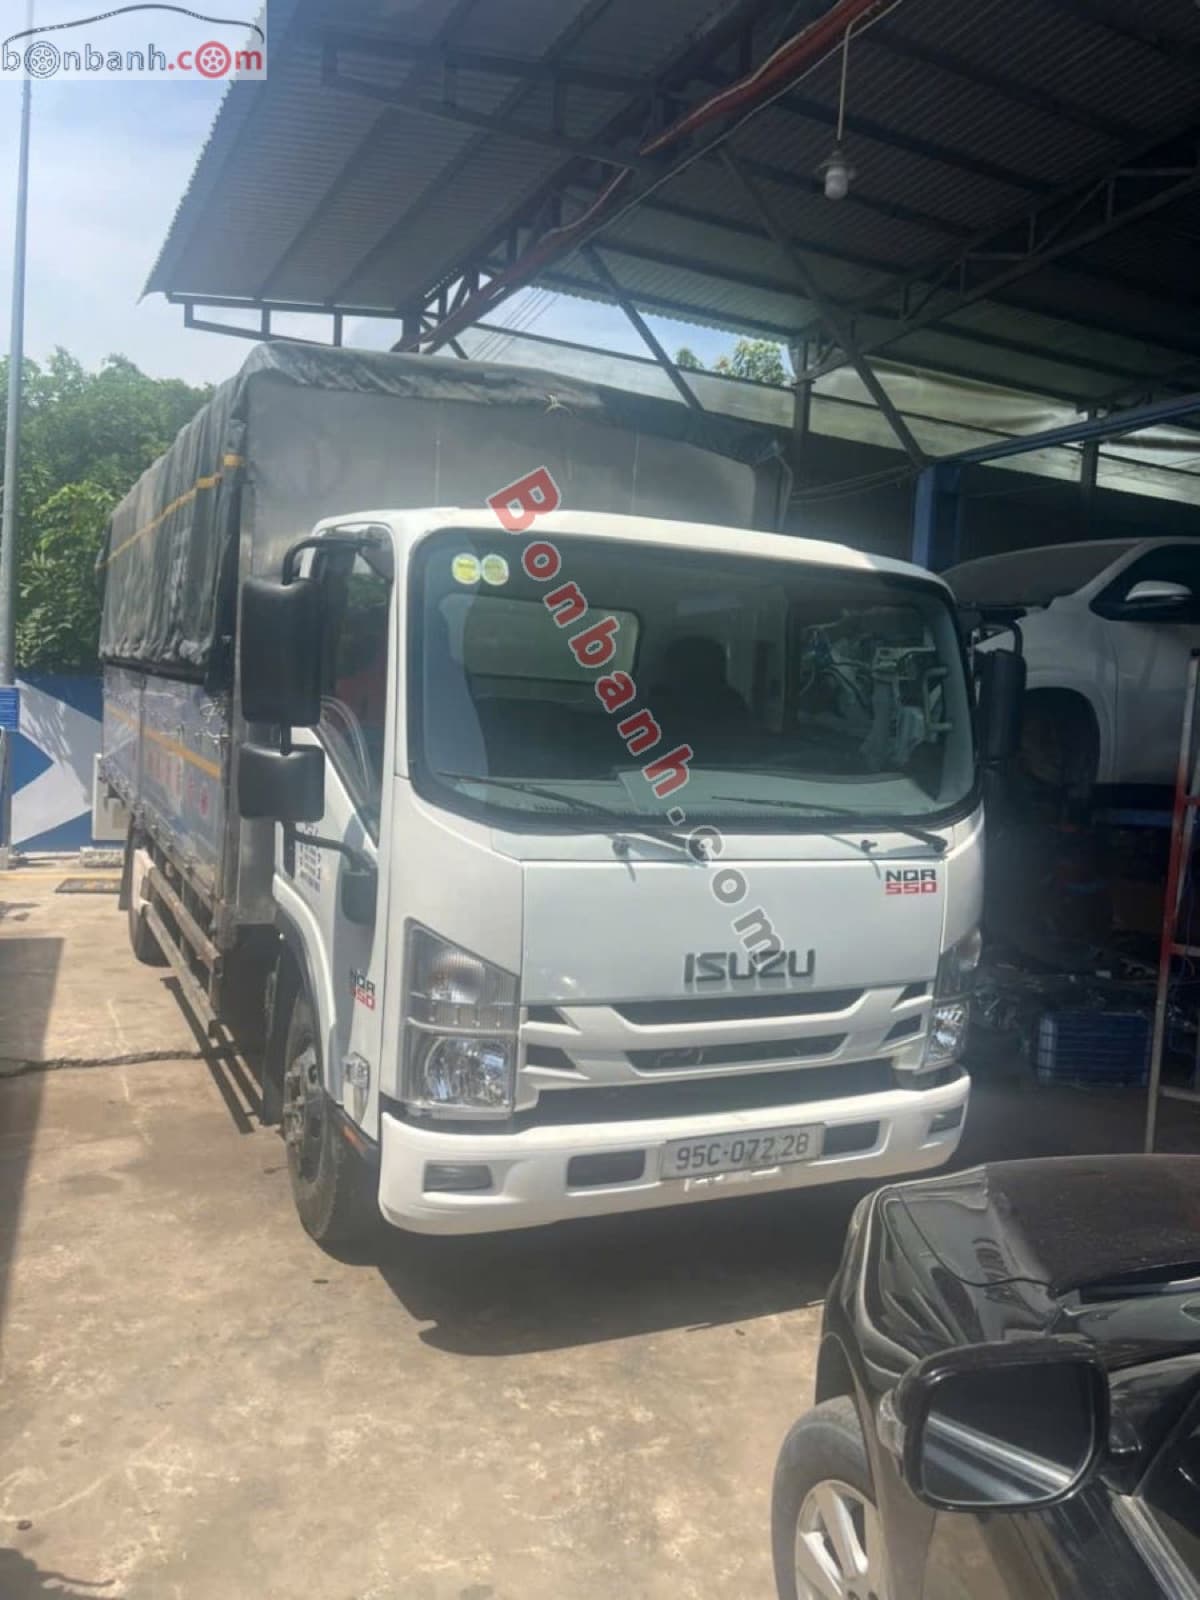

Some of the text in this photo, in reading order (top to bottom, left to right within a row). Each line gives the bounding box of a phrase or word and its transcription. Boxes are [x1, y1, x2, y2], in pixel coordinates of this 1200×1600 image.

[885, 868, 937, 881] NQR
[885, 881, 937, 895] 550
[684, 949, 815, 983] ISUZU
